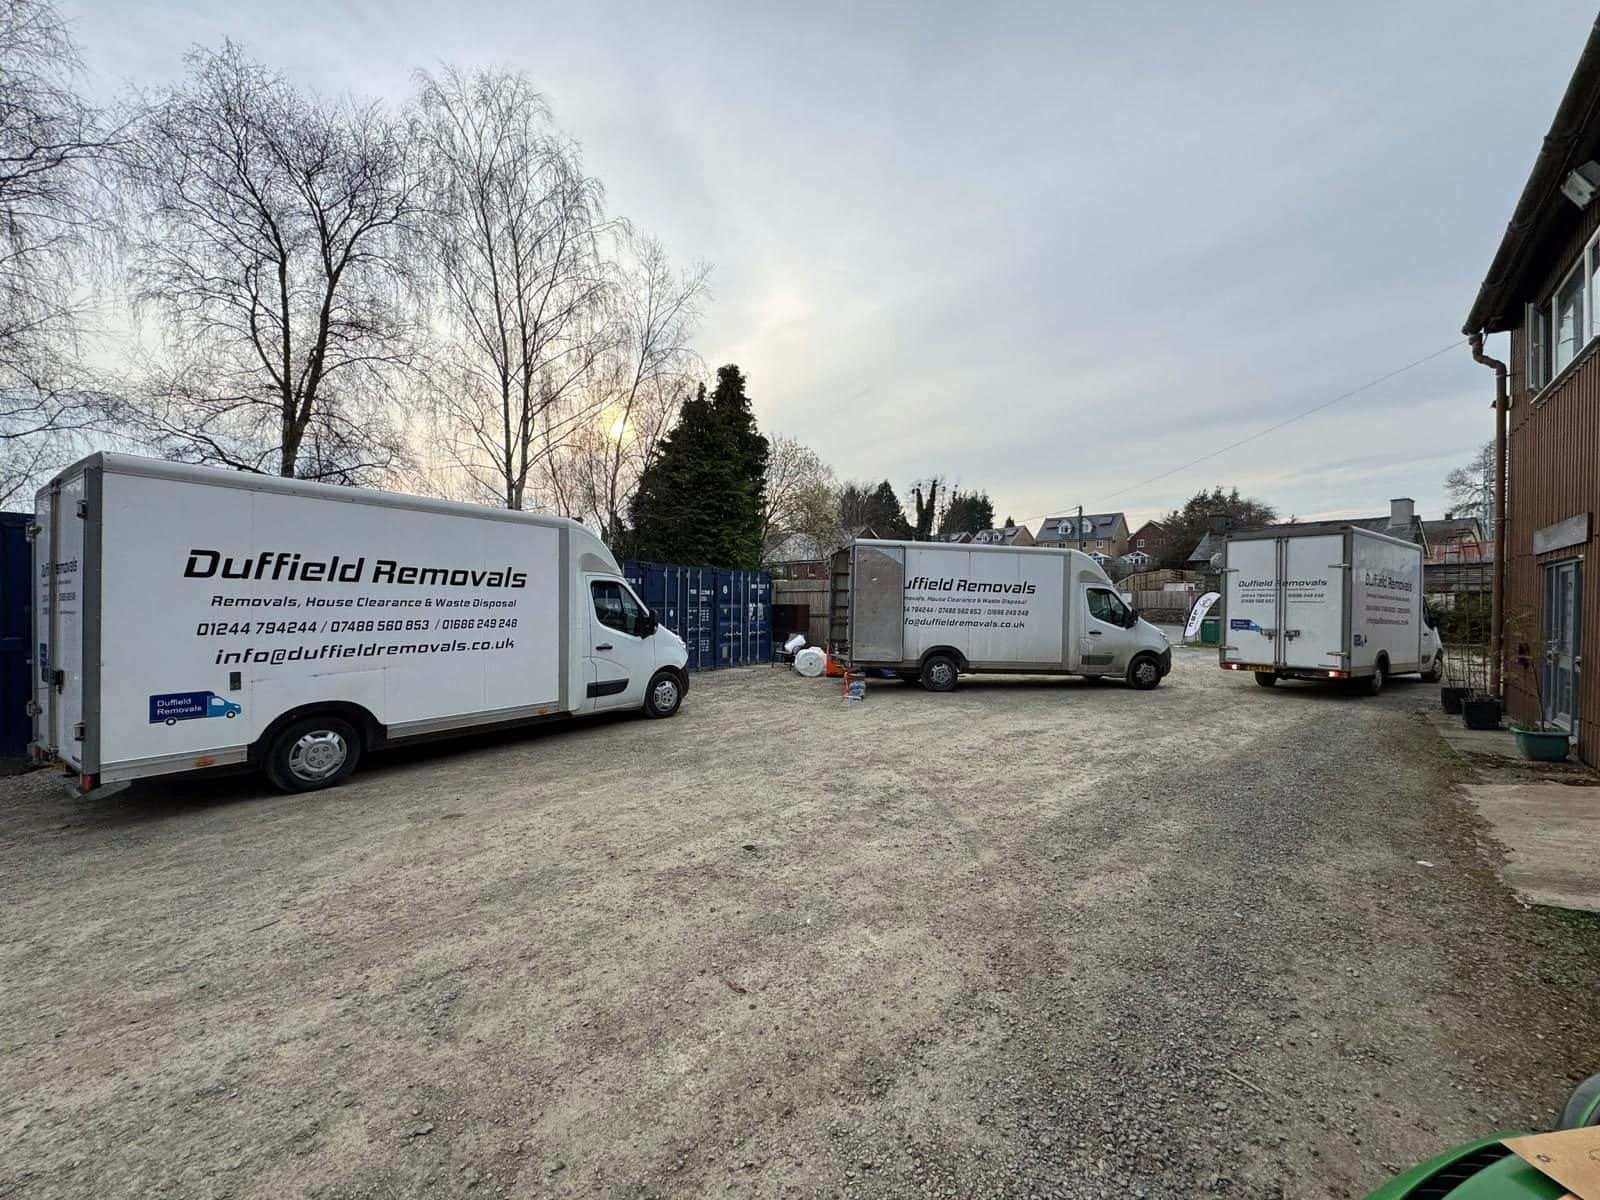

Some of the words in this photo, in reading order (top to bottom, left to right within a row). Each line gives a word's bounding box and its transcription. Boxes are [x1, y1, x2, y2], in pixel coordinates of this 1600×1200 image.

[184, 549, 365, 582] Duffield
[372, 560, 527, 588] Removals
[904, 577, 954, 591] uffield
[956, 580, 1036, 594] Removals
[211, 595, 301, 608] Removals,
[306, 597, 353, 607] House
[357, 597, 422, 607] Clearance
[425, 599, 432, 607] &
[435, 599, 470, 608] Waste
[473, 599, 517, 609] Disposal
[197, 622, 250, 636] 01244
[256, 621, 317, 634] 794244
[331, 620, 374, 632] 07488
[377, 620, 402, 632] 560
[405, 619, 429, 631] 853
[442, 618, 475, 630] 01686
[477, 618, 497, 630] 249
[904, 617, 1025, 628] fo@duffieldremovals.co.uk
[215, 638, 514, 665] info@duffieldremovals.co.uk
[157, 698, 192, 707] Duffield
[157, 705, 202, 715] Removals
